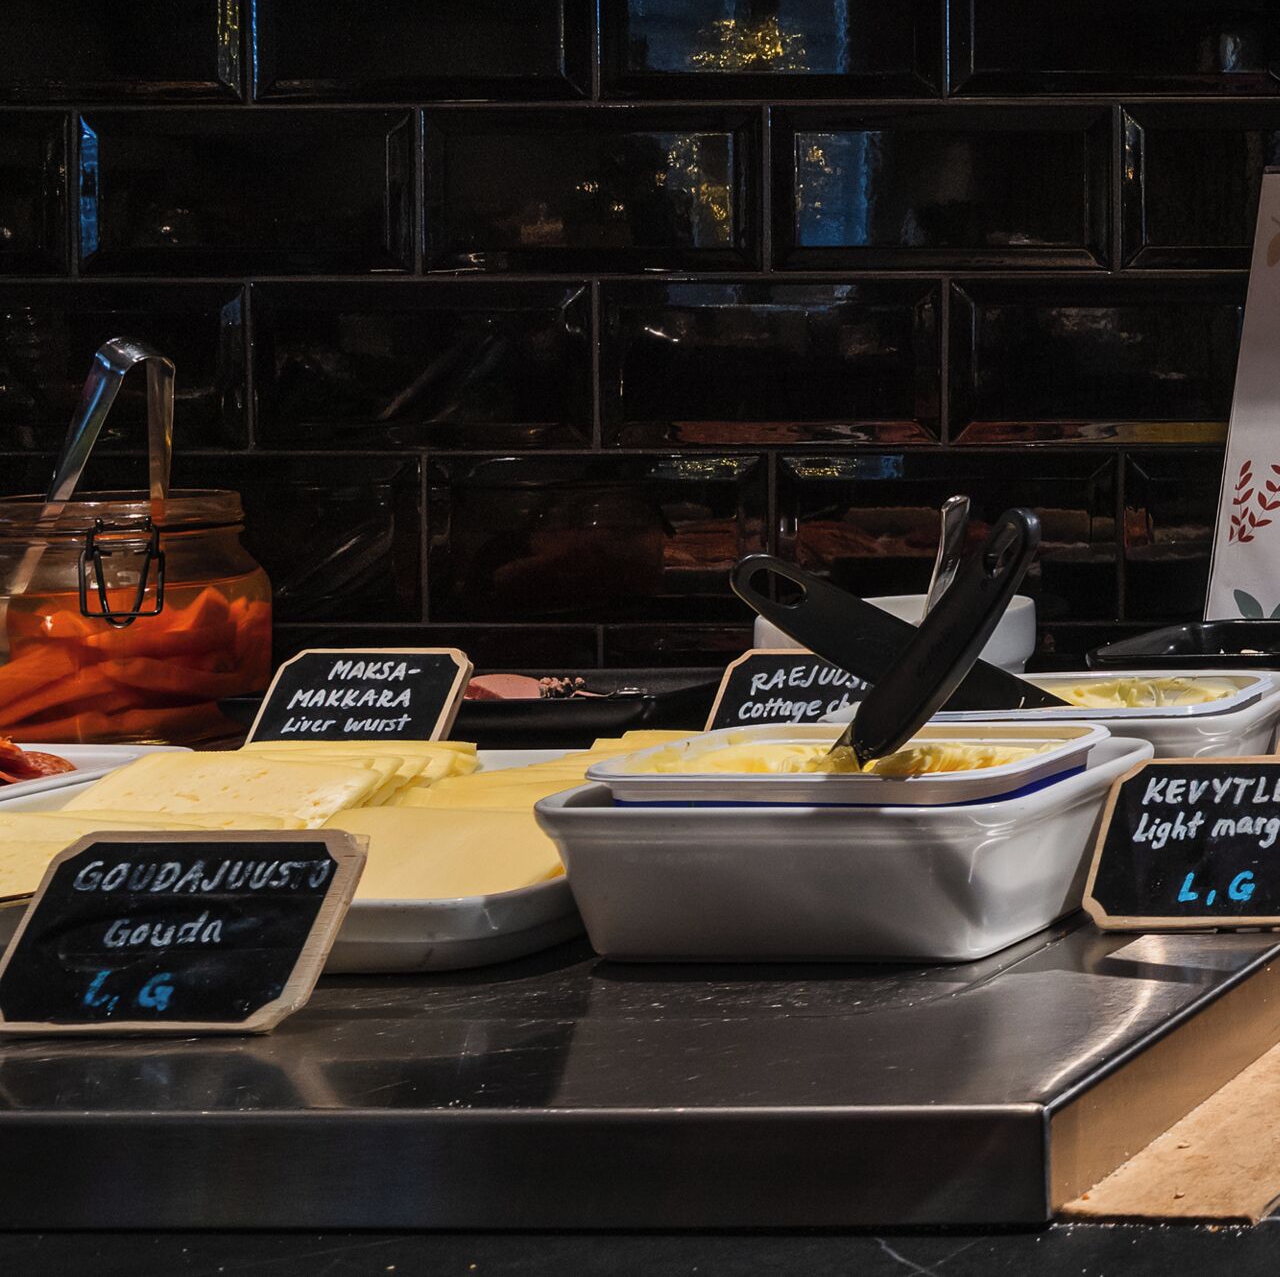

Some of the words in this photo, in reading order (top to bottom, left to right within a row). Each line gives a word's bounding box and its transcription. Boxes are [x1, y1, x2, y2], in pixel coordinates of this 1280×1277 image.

[328, 660, 421, 682] MAKSA-
[286, 688, 412, 710] MAKKARA
[280, 716, 336, 734] Liver
[1132, 811, 1205, 850] Light
[1228, 870, 1256, 901] G
[102, 910, 223, 948] Gouda
[137, 972, 175, 1011] G
